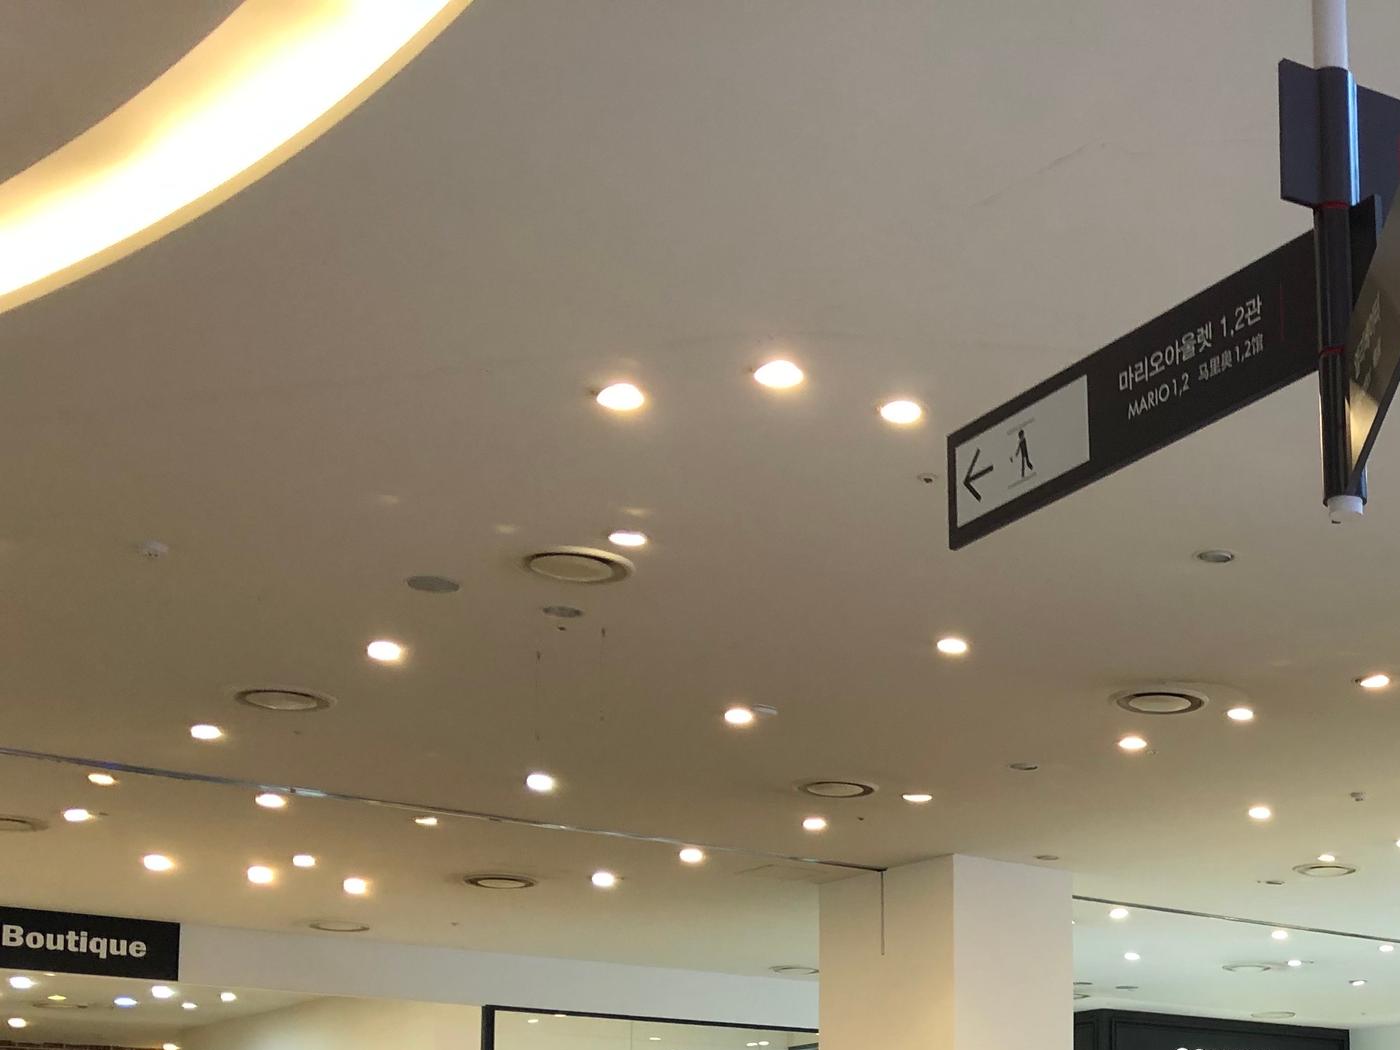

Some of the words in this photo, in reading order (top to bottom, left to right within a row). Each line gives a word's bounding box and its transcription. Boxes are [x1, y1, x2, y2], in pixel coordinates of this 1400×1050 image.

[1118, 320, 1213, 391] 마리오아울렛
[1128, 383, 1171, 420] MARIO
[1, 924, 148, 959] Boutique
